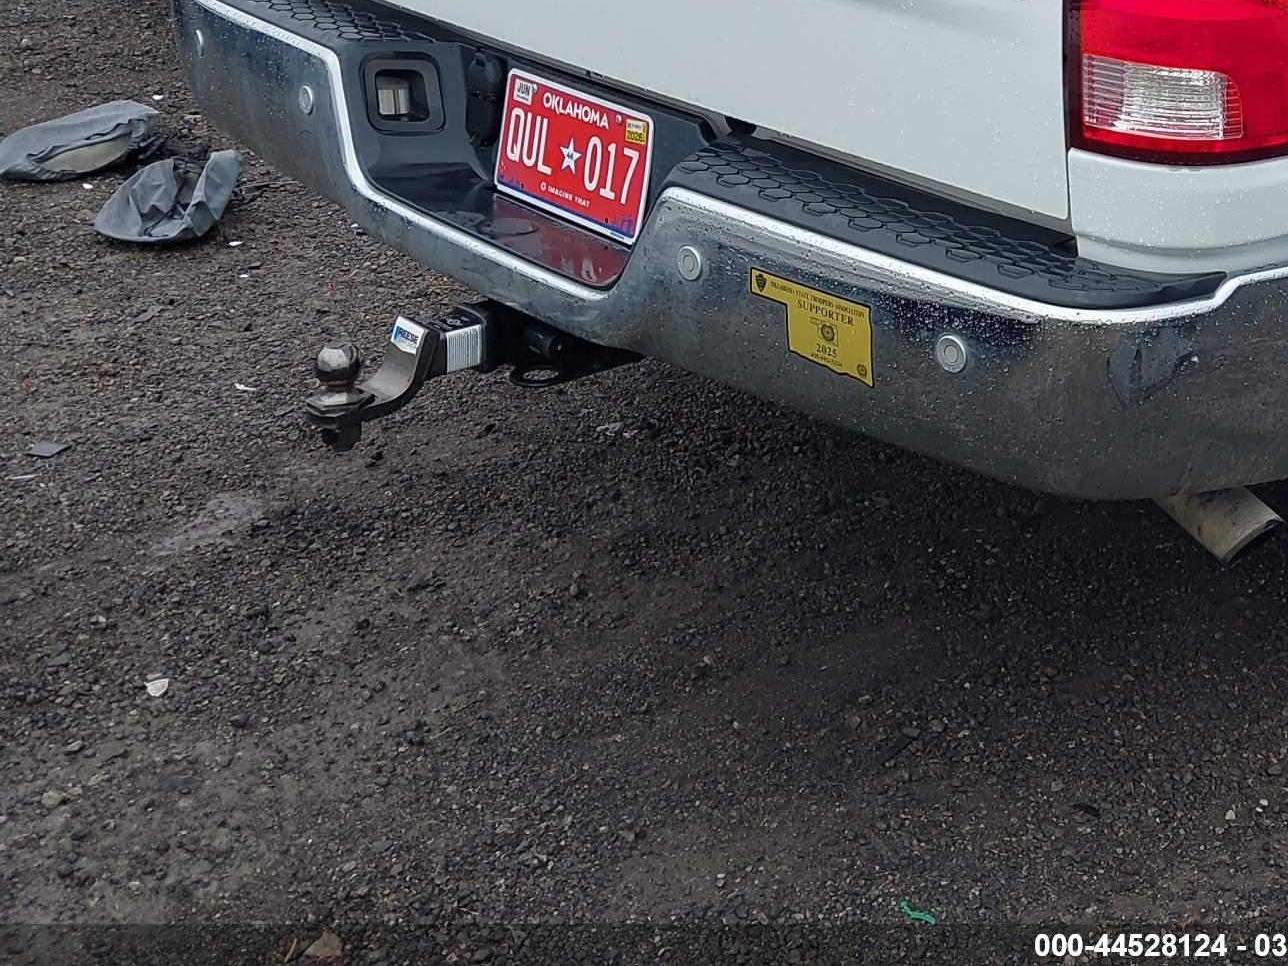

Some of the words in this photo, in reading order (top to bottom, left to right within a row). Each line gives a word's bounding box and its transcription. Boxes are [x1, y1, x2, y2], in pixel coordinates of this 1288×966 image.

[517, 81, 530, 96] JUN
[542, 92, 609, 130] OKLAHOMA
[506, 107, 552, 176] QUL
[583, 136, 640, 205] 017
[547, 185, 573, 202] IMAGINE
[574, 195, 591, 208] THAT
[797, 298, 854, 327] SUPPORTER
[399, 328, 419, 345] REESE
[815, 342, 838, 359] 2025
